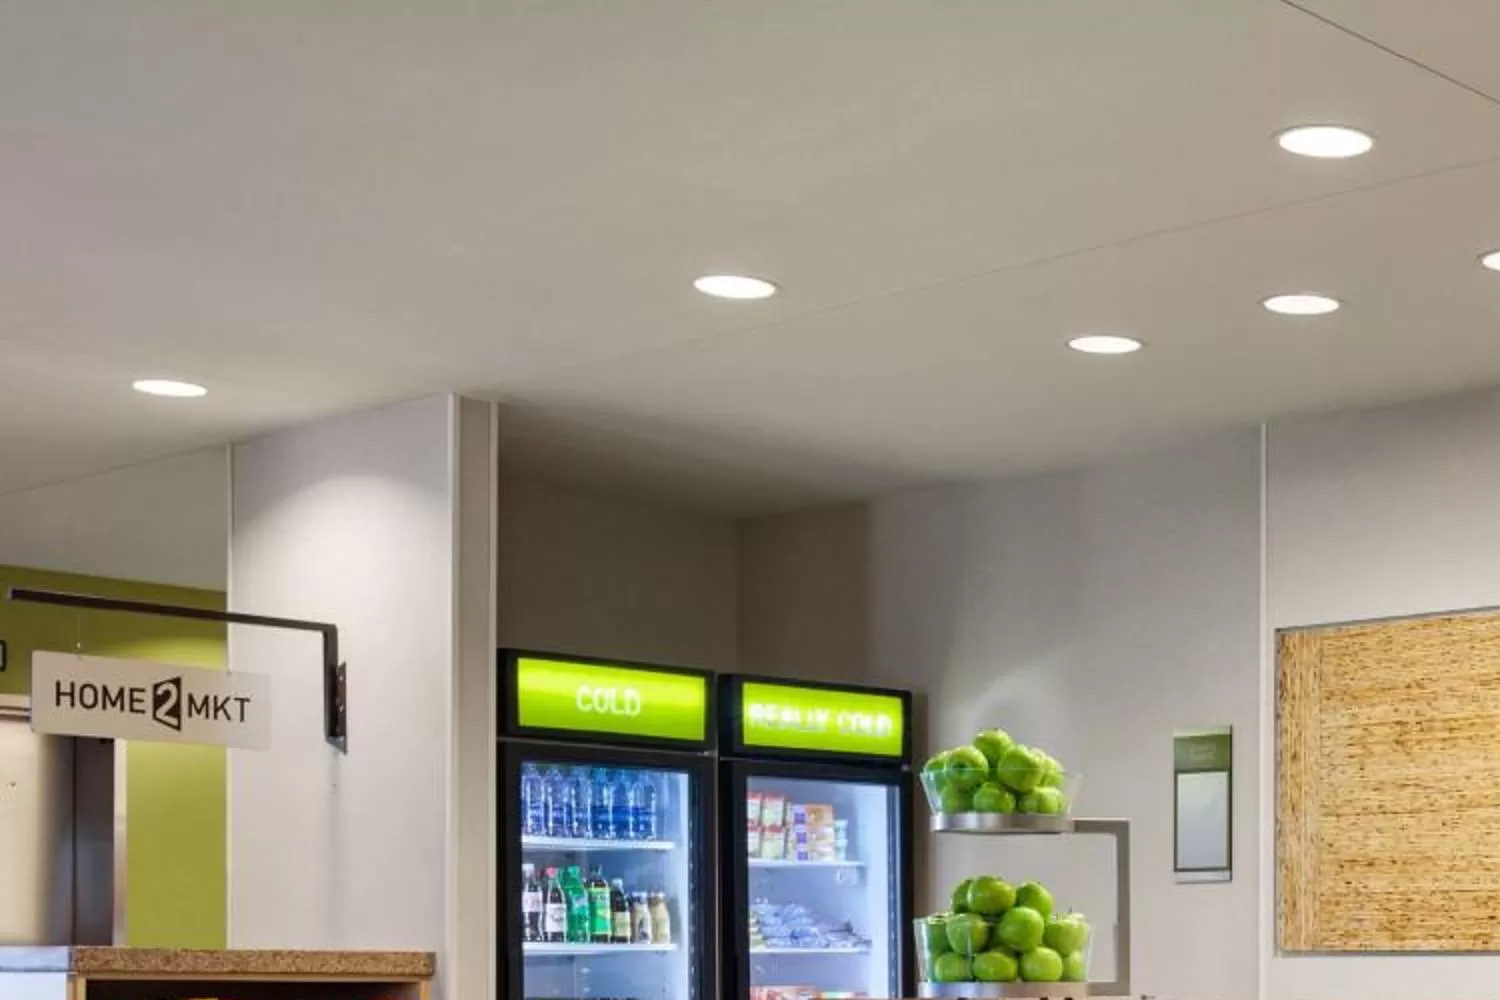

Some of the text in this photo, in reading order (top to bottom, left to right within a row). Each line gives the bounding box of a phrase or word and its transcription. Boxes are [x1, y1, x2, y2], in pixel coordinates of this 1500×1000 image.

[55, 679, 146, 715] HOME
[187, 692, 252, 723] MKT
[576, 684, 641, 717] COLD
